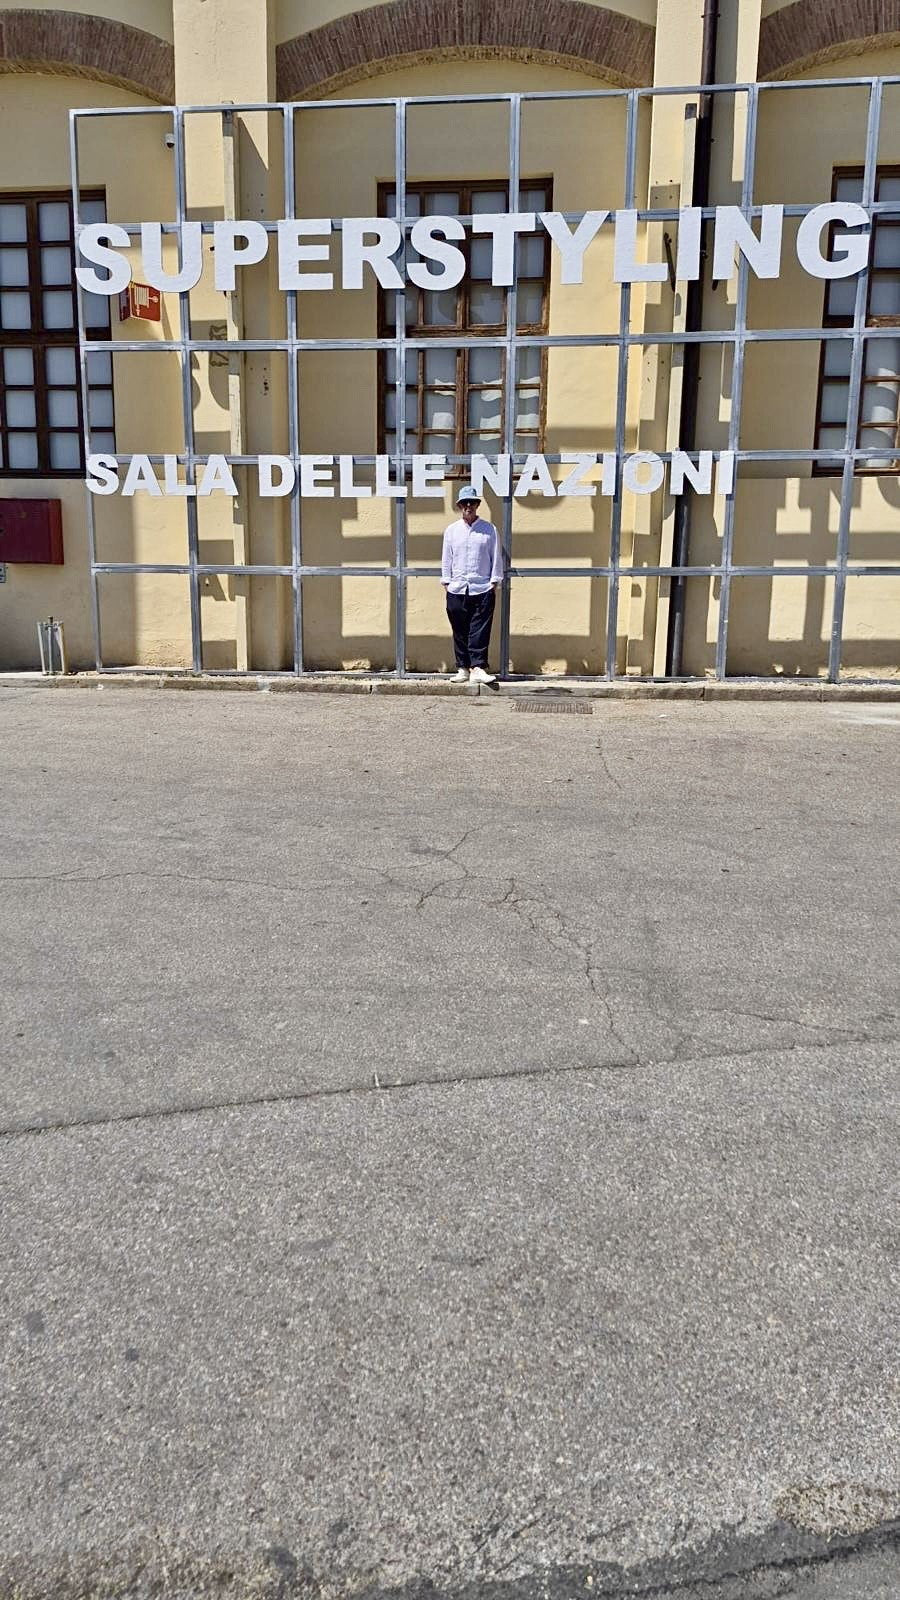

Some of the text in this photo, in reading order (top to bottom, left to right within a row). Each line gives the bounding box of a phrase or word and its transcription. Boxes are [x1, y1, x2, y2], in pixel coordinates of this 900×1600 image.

[75, 202, 870, 295] SUPERSTYLING
[86, 451, 735, 497] SALA DELLE NAZIONI
